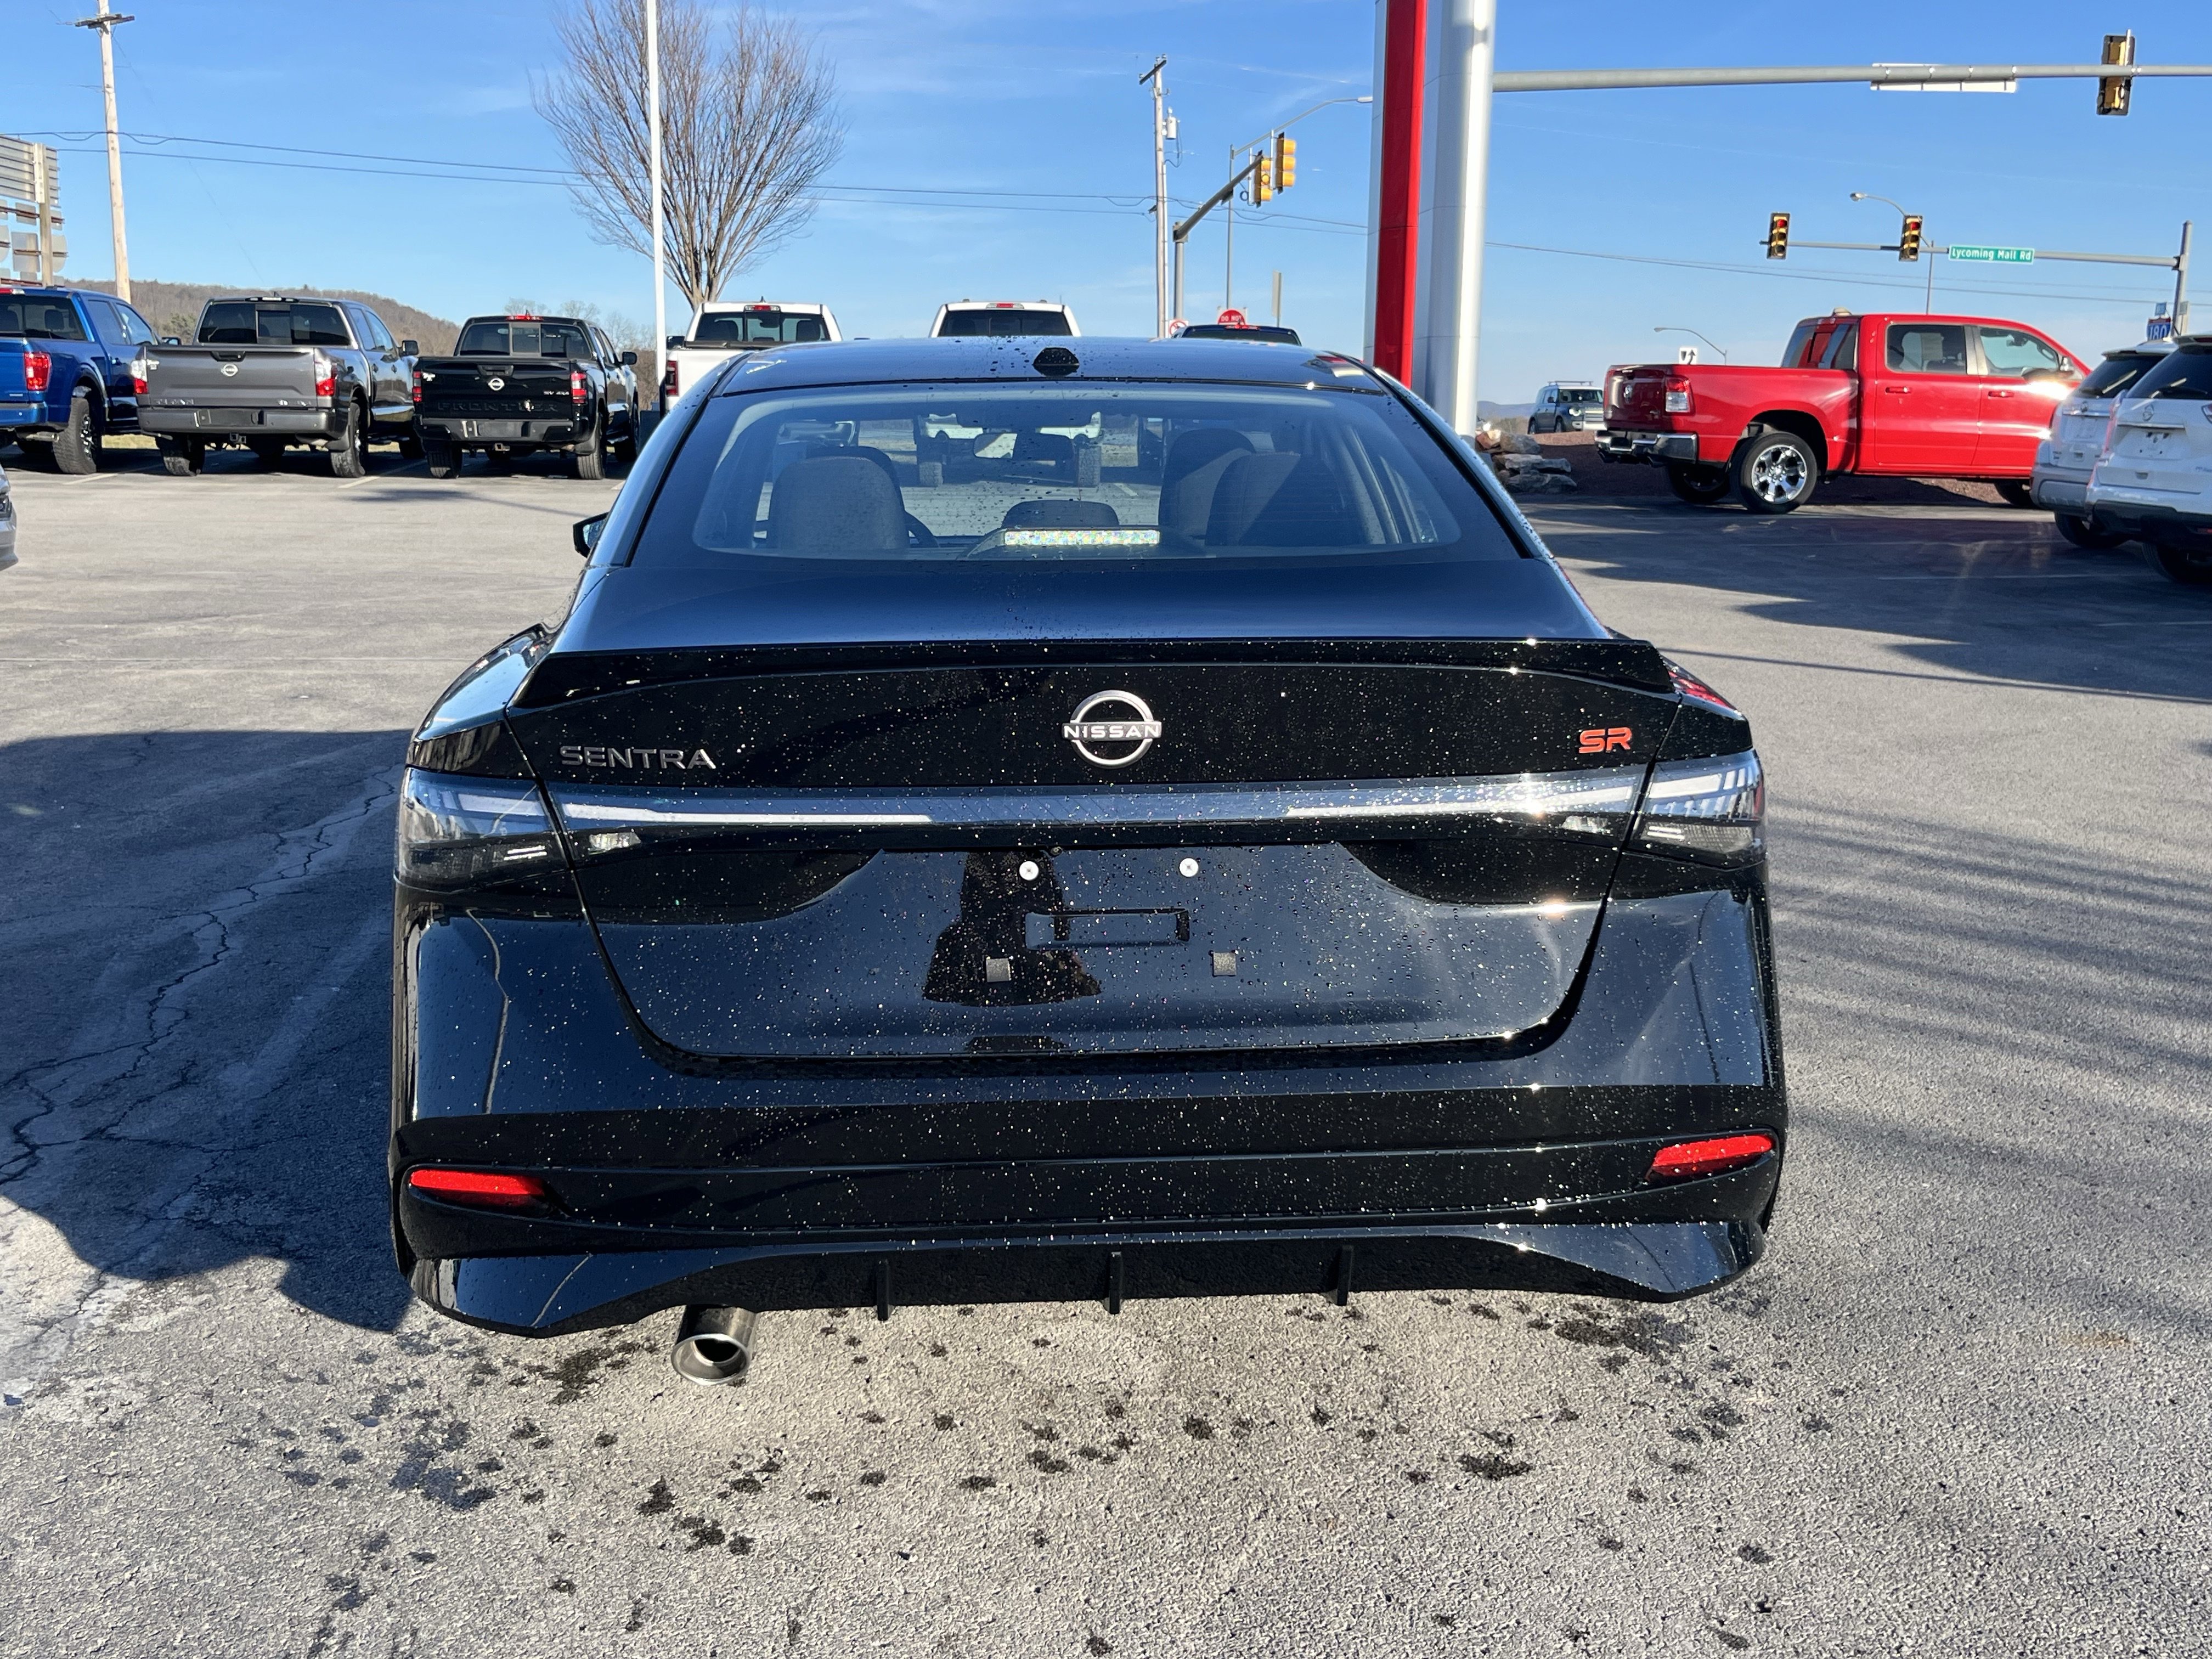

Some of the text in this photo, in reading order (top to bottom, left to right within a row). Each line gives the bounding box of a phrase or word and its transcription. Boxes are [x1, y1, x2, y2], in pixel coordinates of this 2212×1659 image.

[1952, 248, 2031, 261] Lycoming Mall Rd
[2149, 324, 2167, 340] 180
[1063, 725, 1159, 738] NISSAN
[1578, 727, 1632, 753] SR
[560, 746, 716, 769] SENTRA
